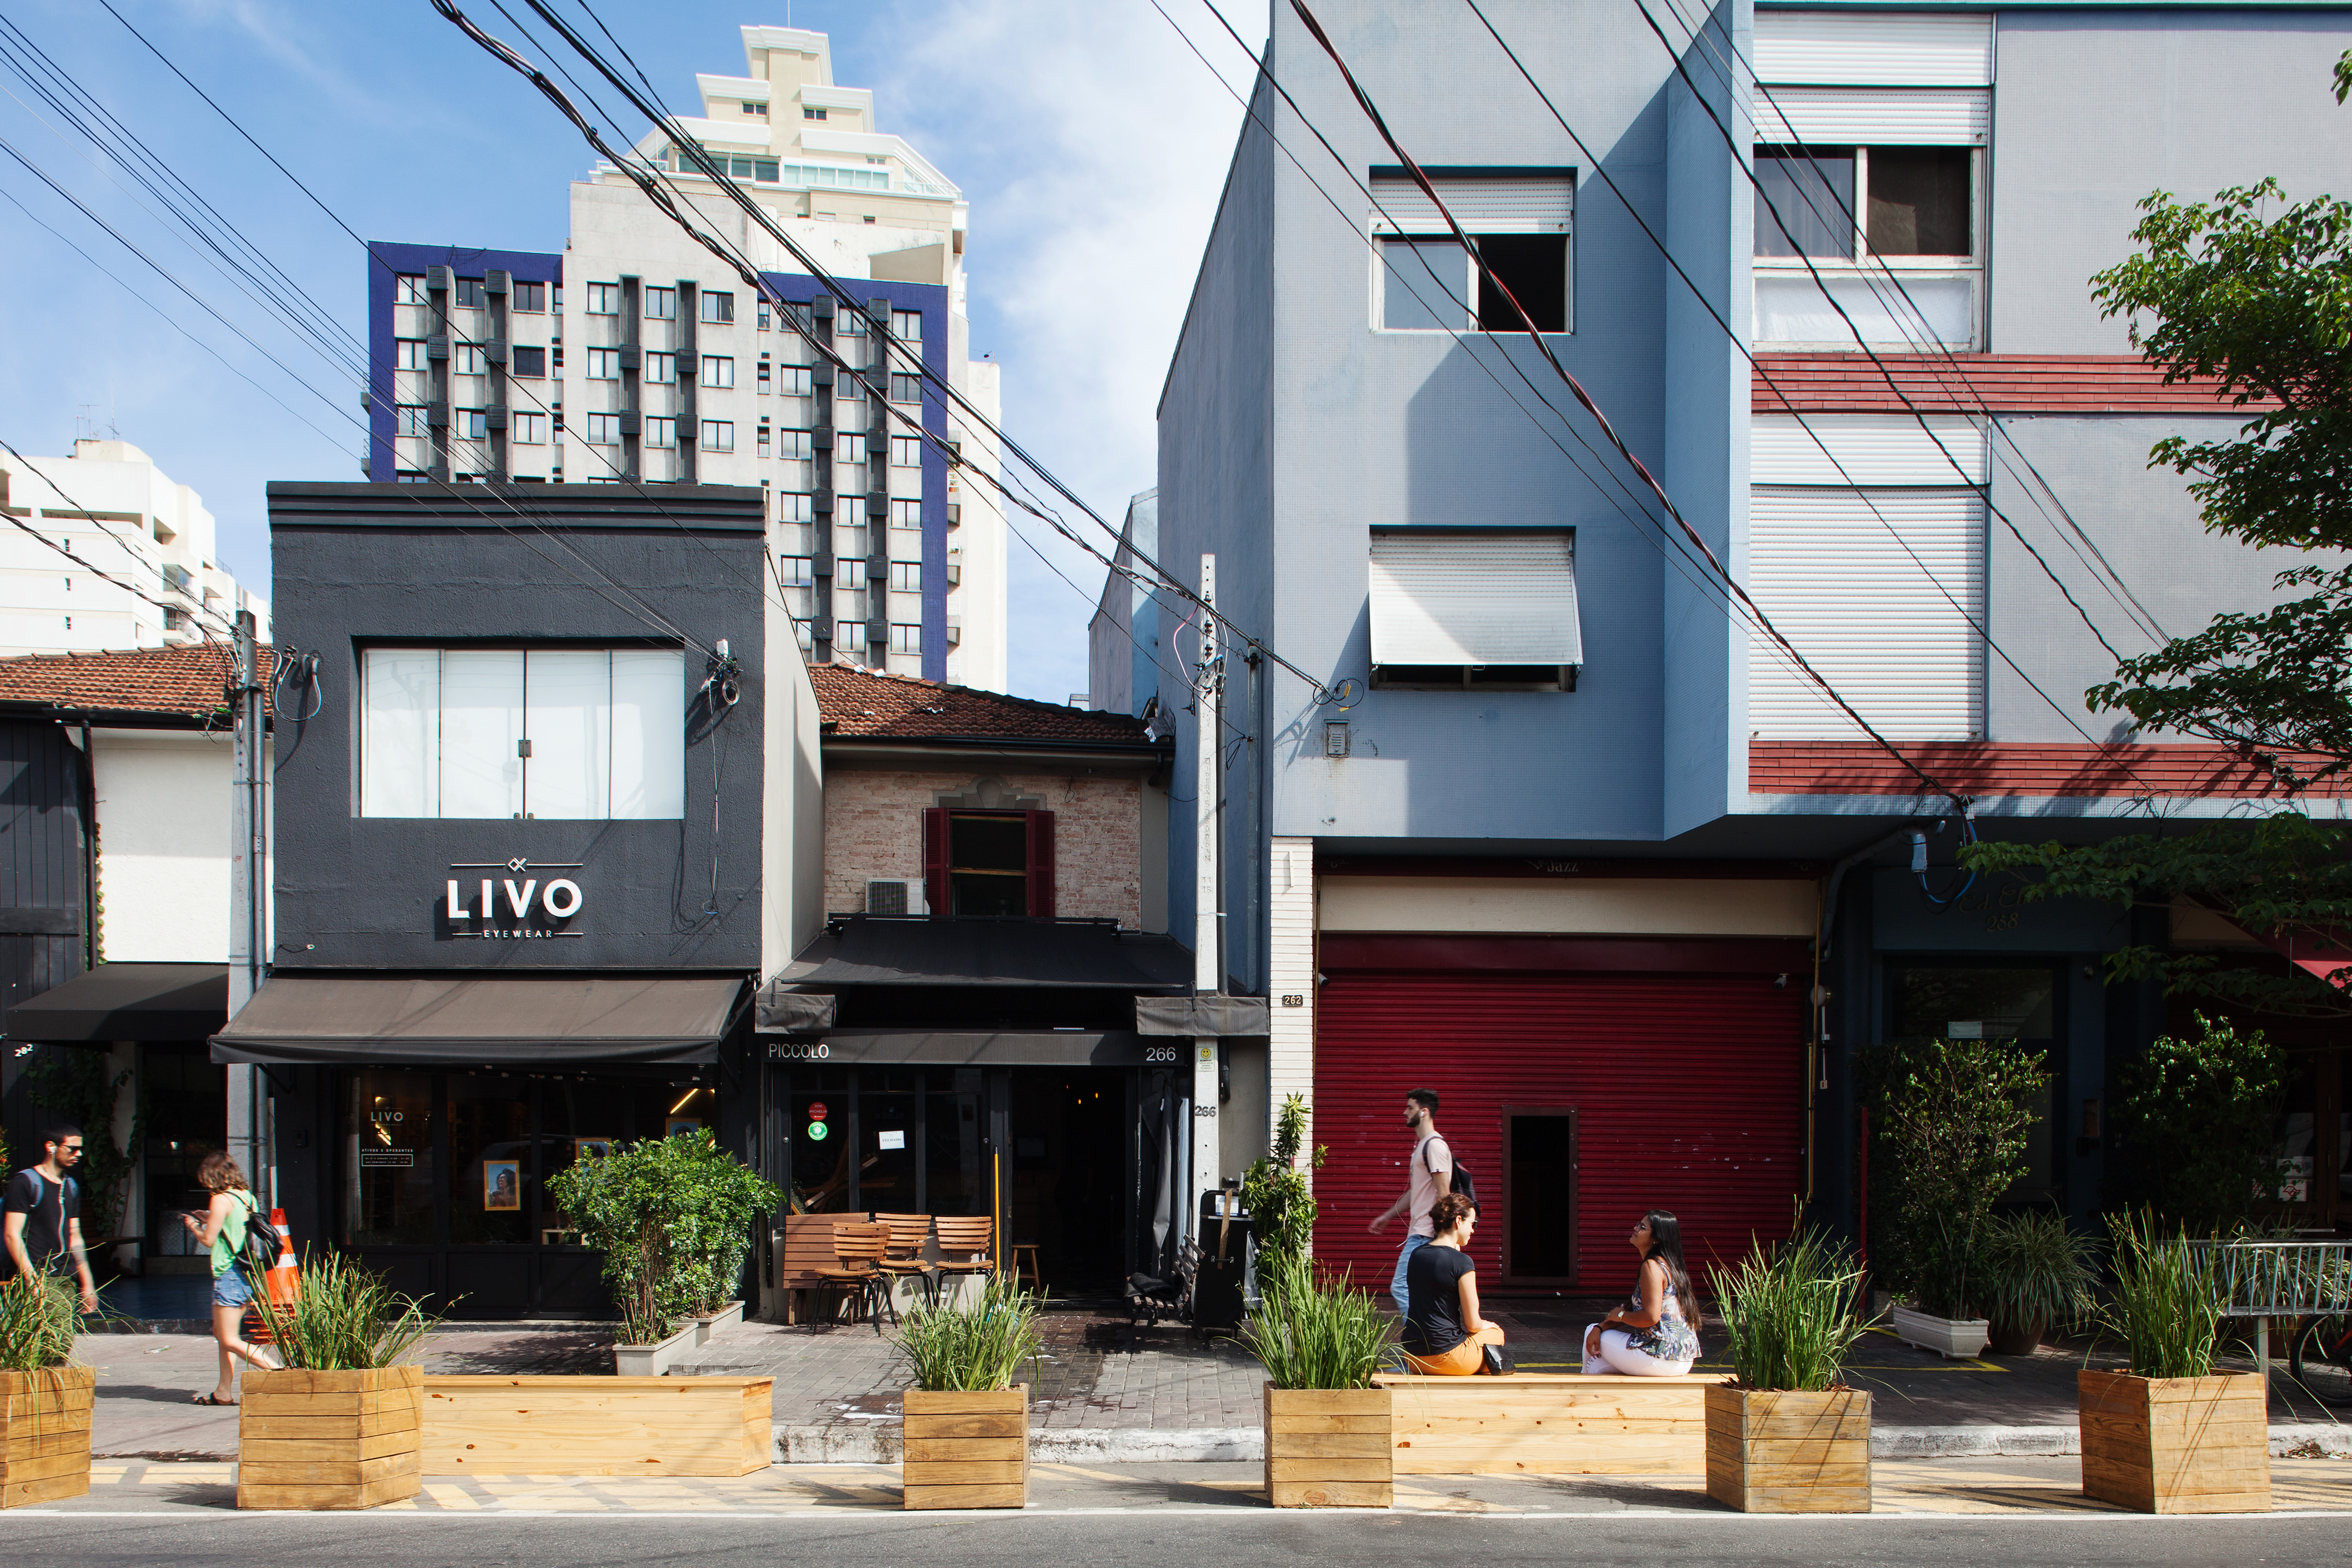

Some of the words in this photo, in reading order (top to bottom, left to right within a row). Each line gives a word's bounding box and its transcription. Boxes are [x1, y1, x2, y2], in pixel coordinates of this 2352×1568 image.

[1547, 859, 1578, 872] Jazz
[448, 879, 583, 918] LIVO
[1985, 912, 2019, 932] 258
[483, 929, 552, 938] EYEWEAR
[1284, 996, 1301, 1006] 262
[14, 1043, 34, 1057] 282
[769, 1043, 830, 1059] PICCOLO
[1146, 1047, 1176, 1062] 266
[370, 1112, 403, 1121] LIVO
[1194, 1105, 1216, 1117] 266
